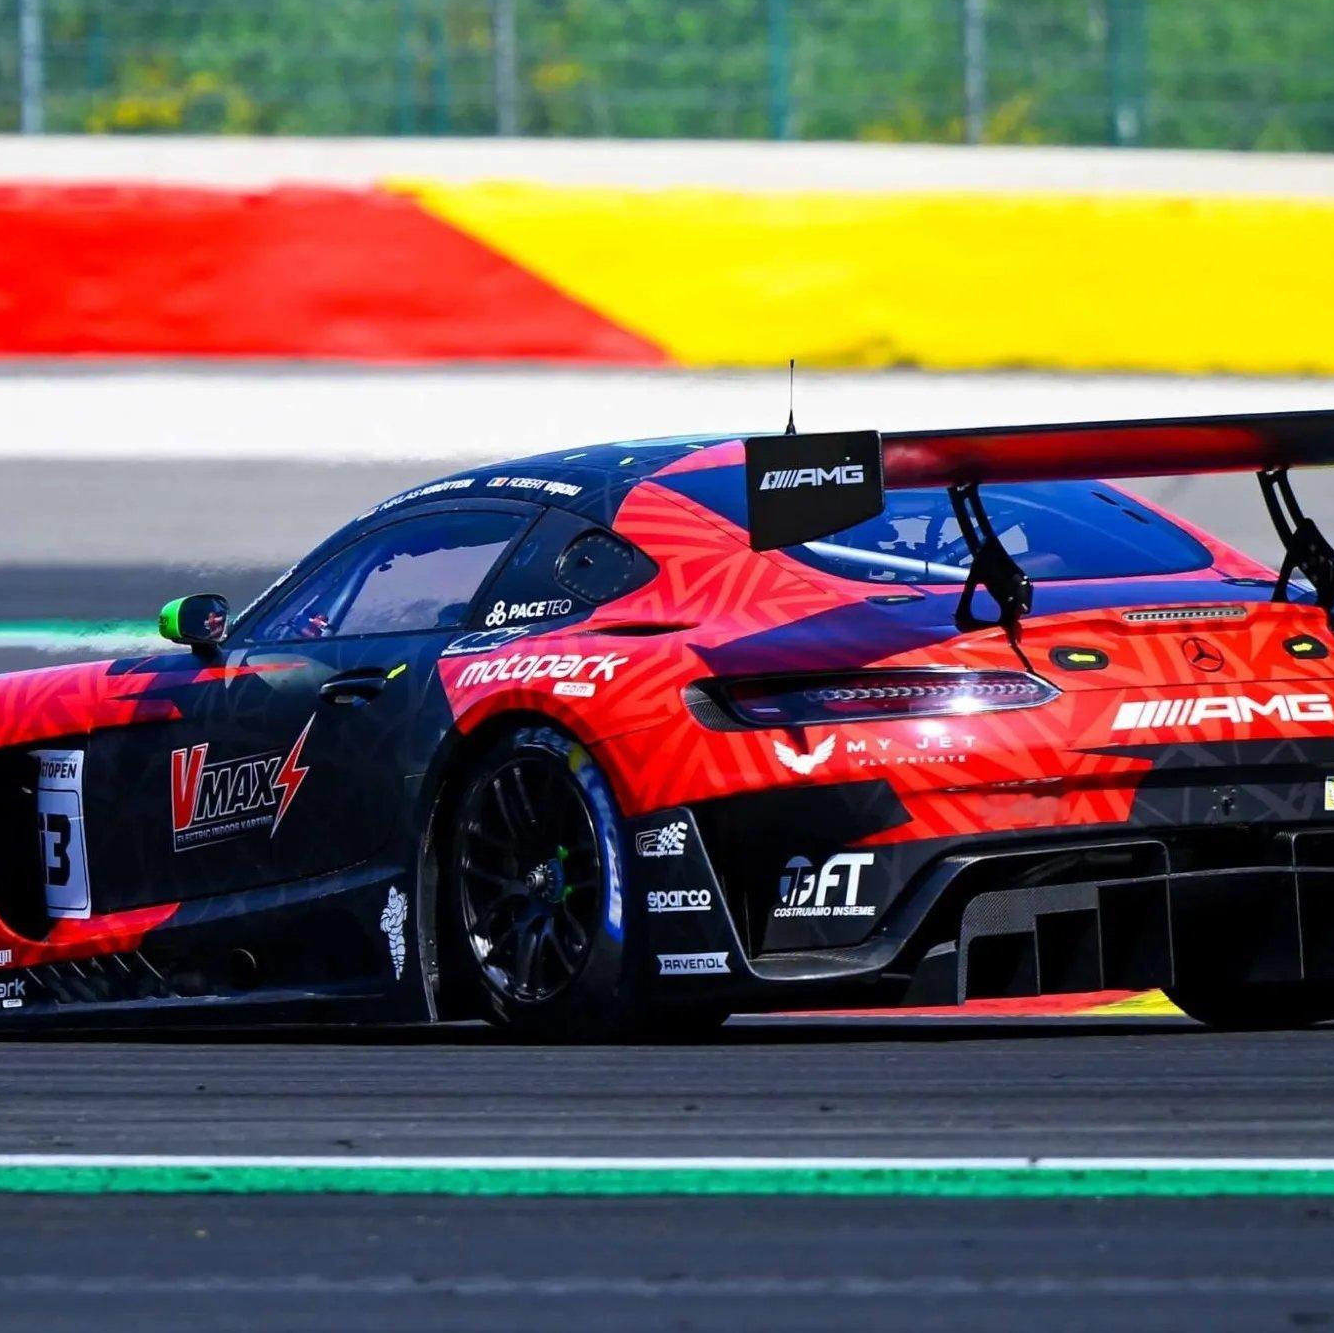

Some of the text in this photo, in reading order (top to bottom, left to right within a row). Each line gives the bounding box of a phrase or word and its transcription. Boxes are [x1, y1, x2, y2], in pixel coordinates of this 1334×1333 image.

[793, 465, 864, 487] AMG
[455, 653, 629, 689] motopark
[846, 736, 977, 753] MY JET
[172, 743, 282, 832] VMAX
[647, 889, 711, 912] sparco
[773, 906, 876, 917] COSTRUIAMO INSIEME
[663, 958, 724, 970] RAVENOL
